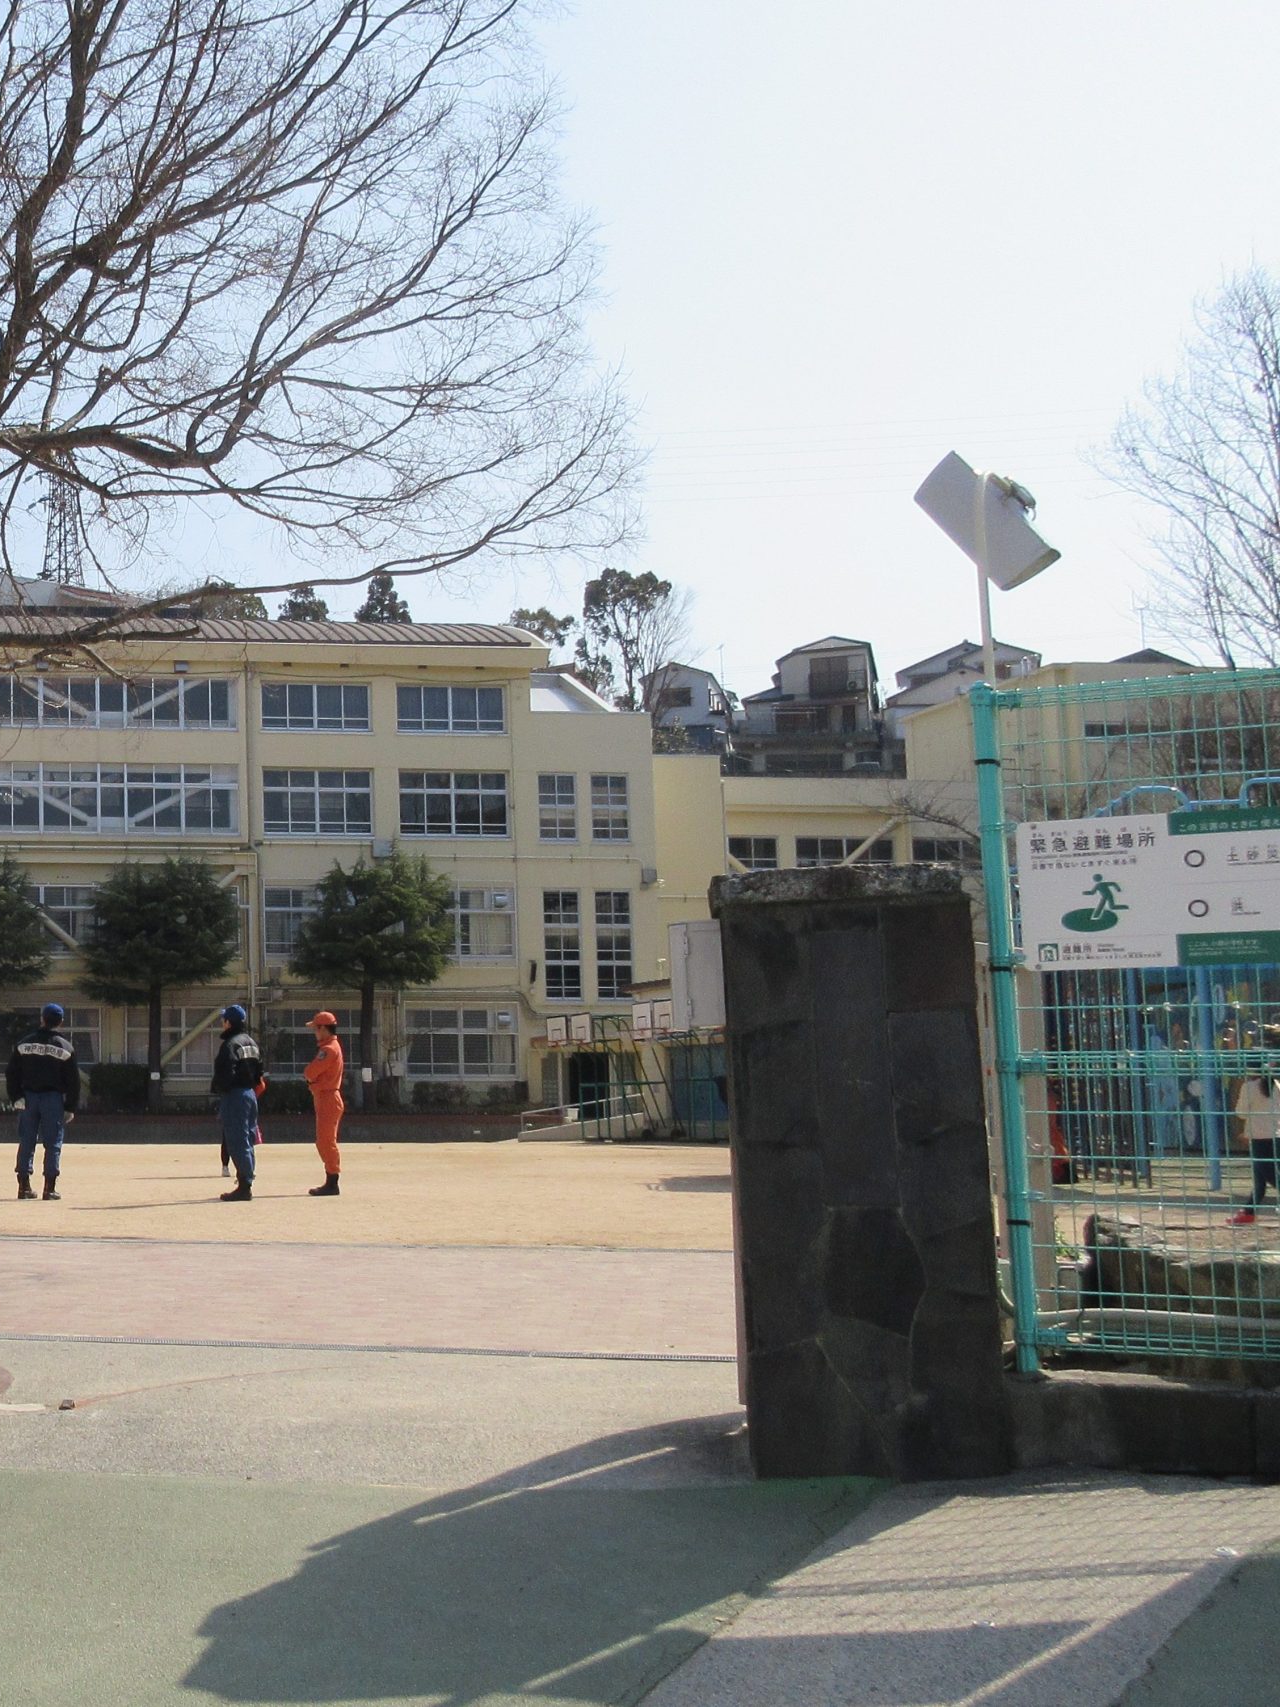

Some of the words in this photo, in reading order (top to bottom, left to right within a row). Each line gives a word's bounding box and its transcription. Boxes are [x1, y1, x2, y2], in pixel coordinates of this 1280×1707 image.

[1029, 831, 1156, 854] 緊急避難場所
